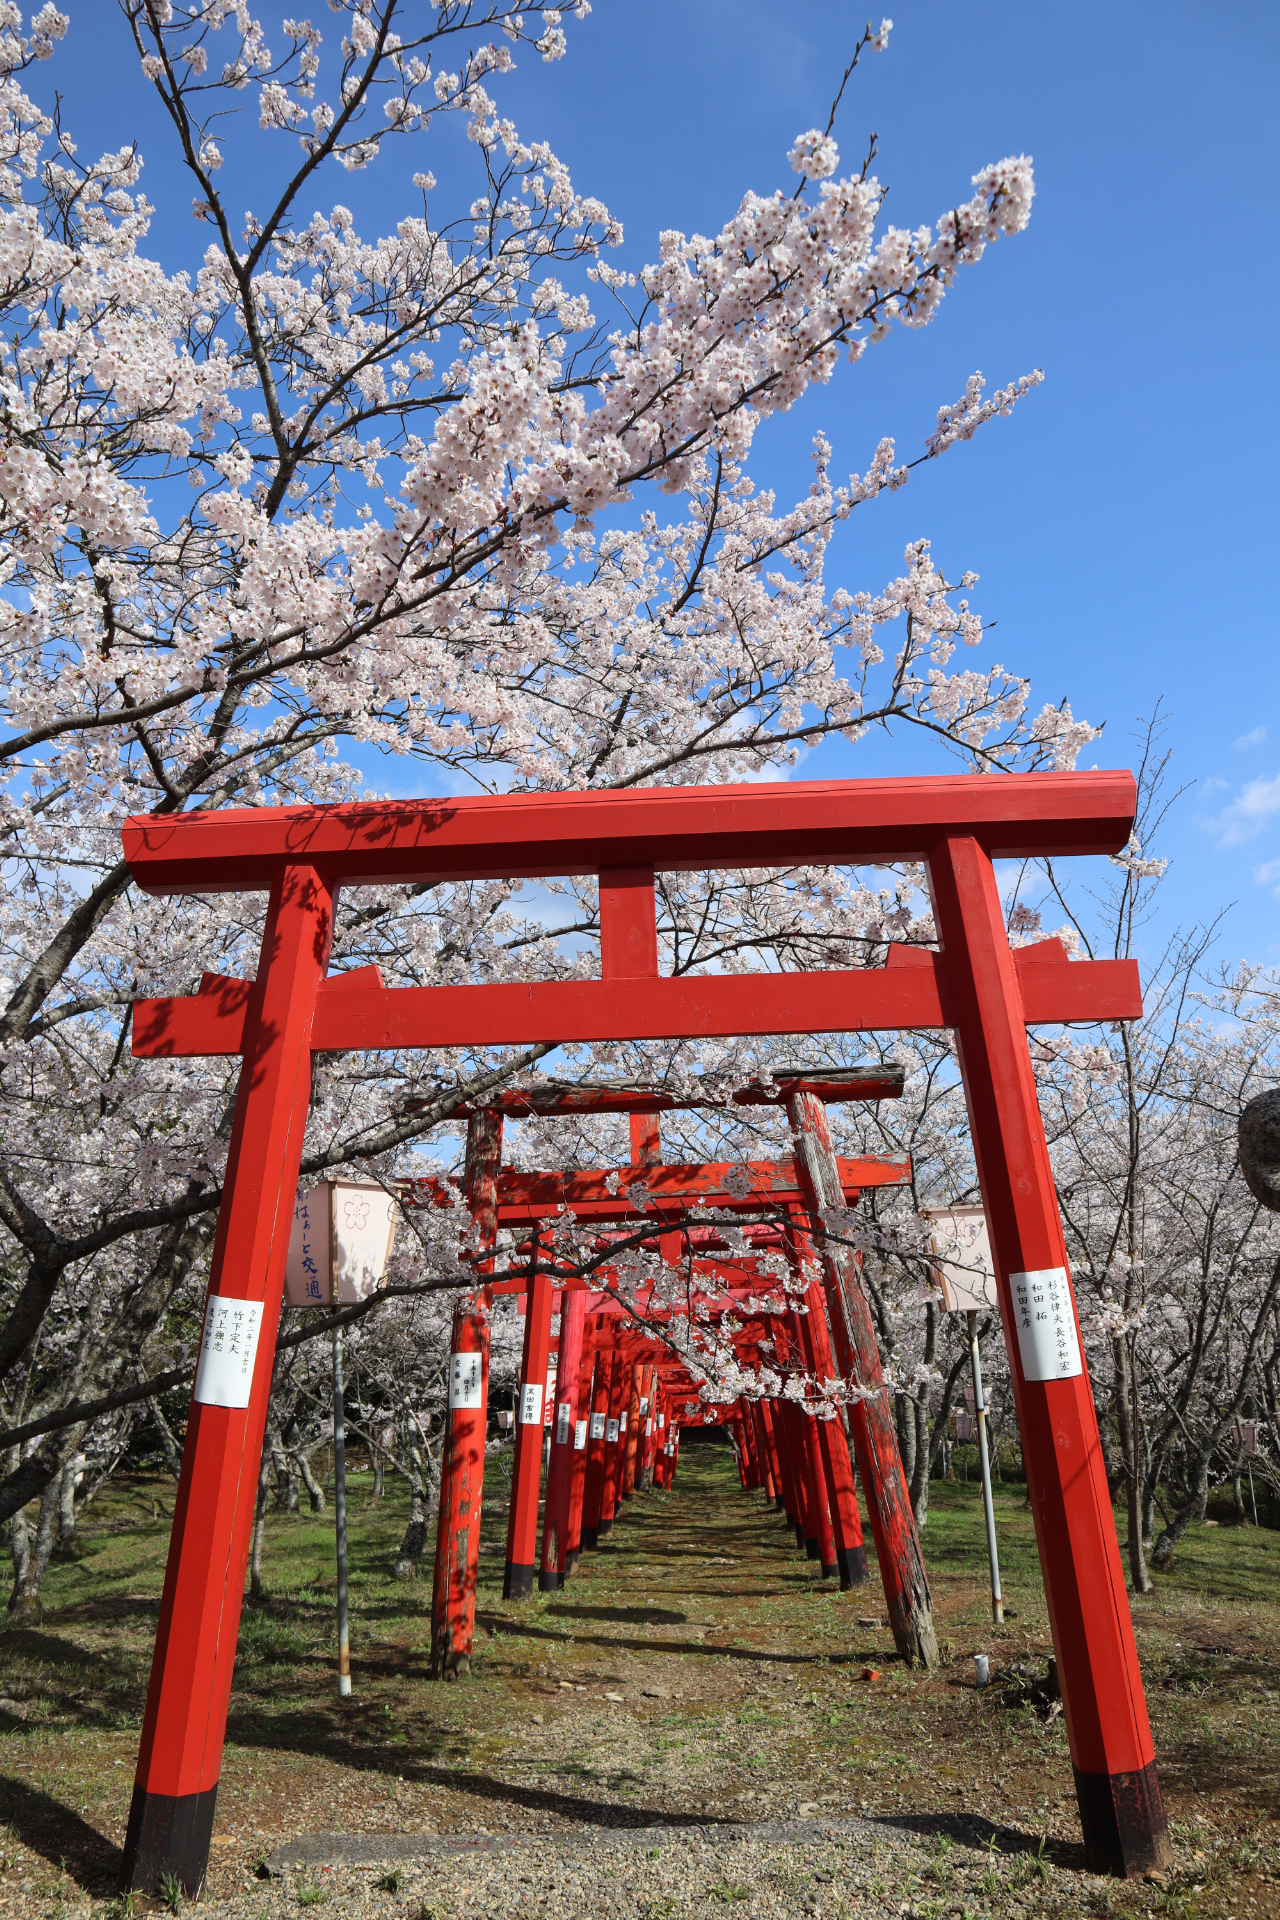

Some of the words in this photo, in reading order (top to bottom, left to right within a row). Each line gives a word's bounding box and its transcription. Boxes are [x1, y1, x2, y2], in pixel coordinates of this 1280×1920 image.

[212, 1308, 229, 1352] 河上強志
[228, 1310, 244, 1355] 竹下定夫
[242, 1308, 257, 1374] 令和二年一月吉日
